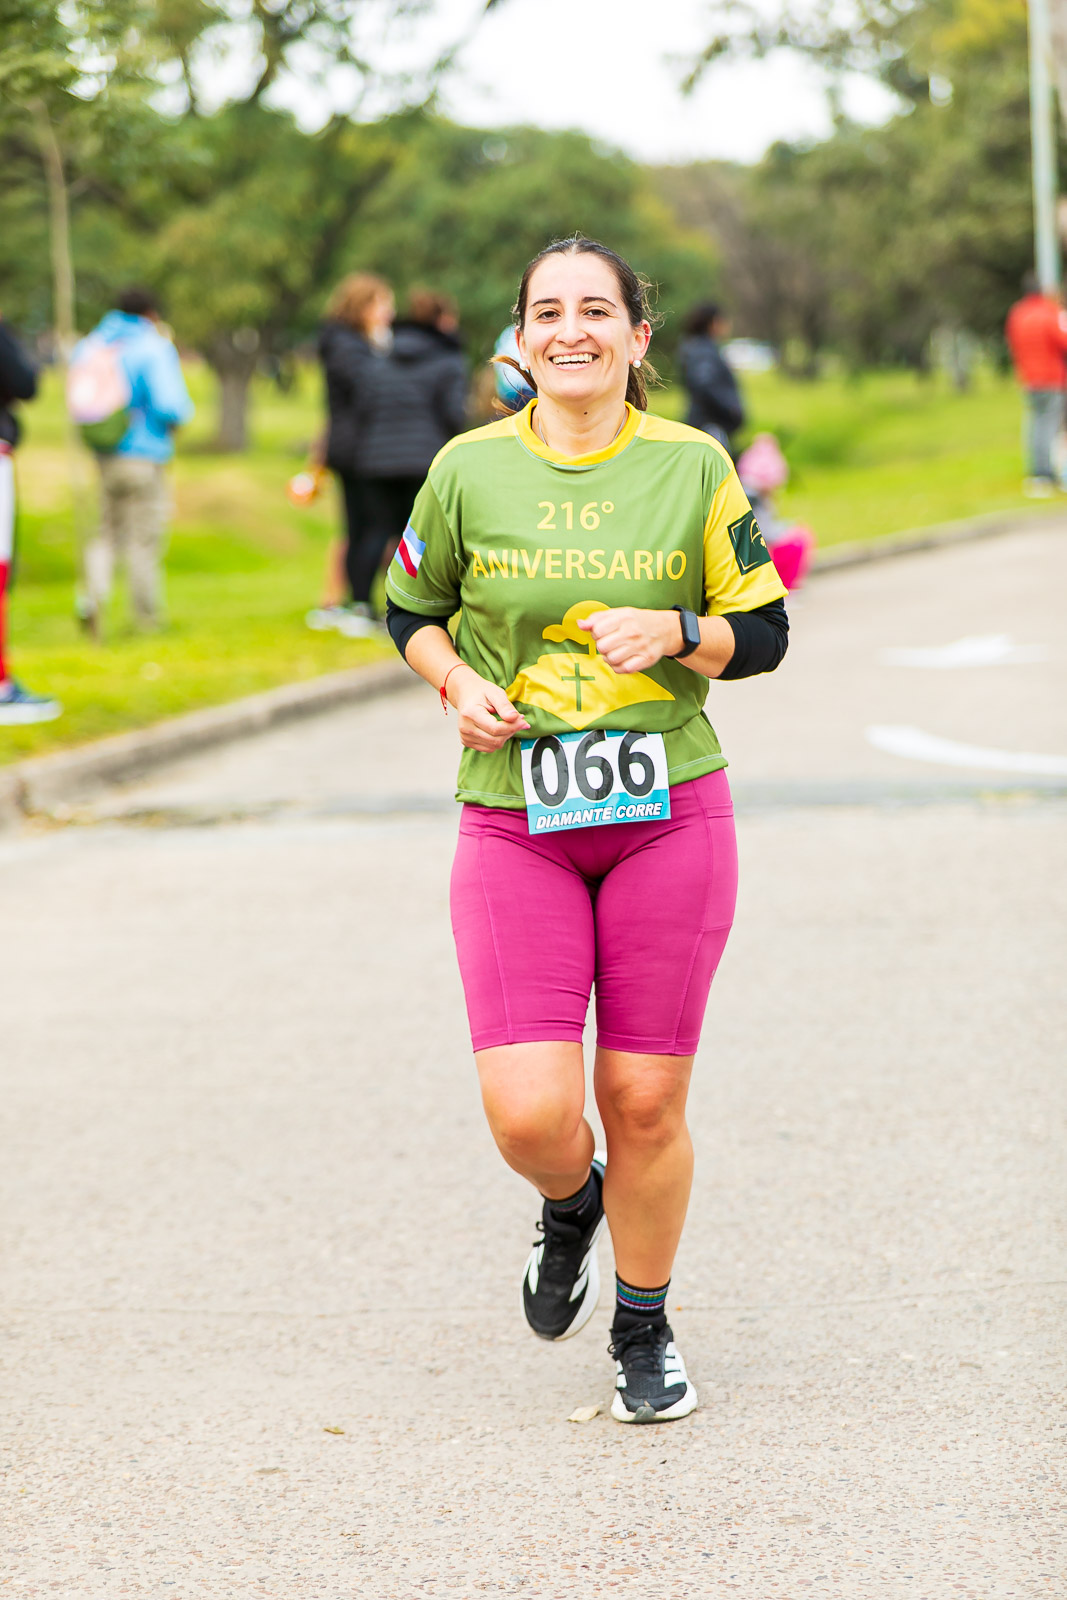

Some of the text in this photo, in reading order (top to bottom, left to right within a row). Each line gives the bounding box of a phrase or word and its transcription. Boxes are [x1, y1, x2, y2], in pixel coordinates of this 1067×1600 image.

[536, 500, 615, 531] 216°
[472, 549, 687, 581] ANIVERSARIO
[529, 729, 656, 807] 066
[535, 802, 663, 830] DIAMANTE CORRE
